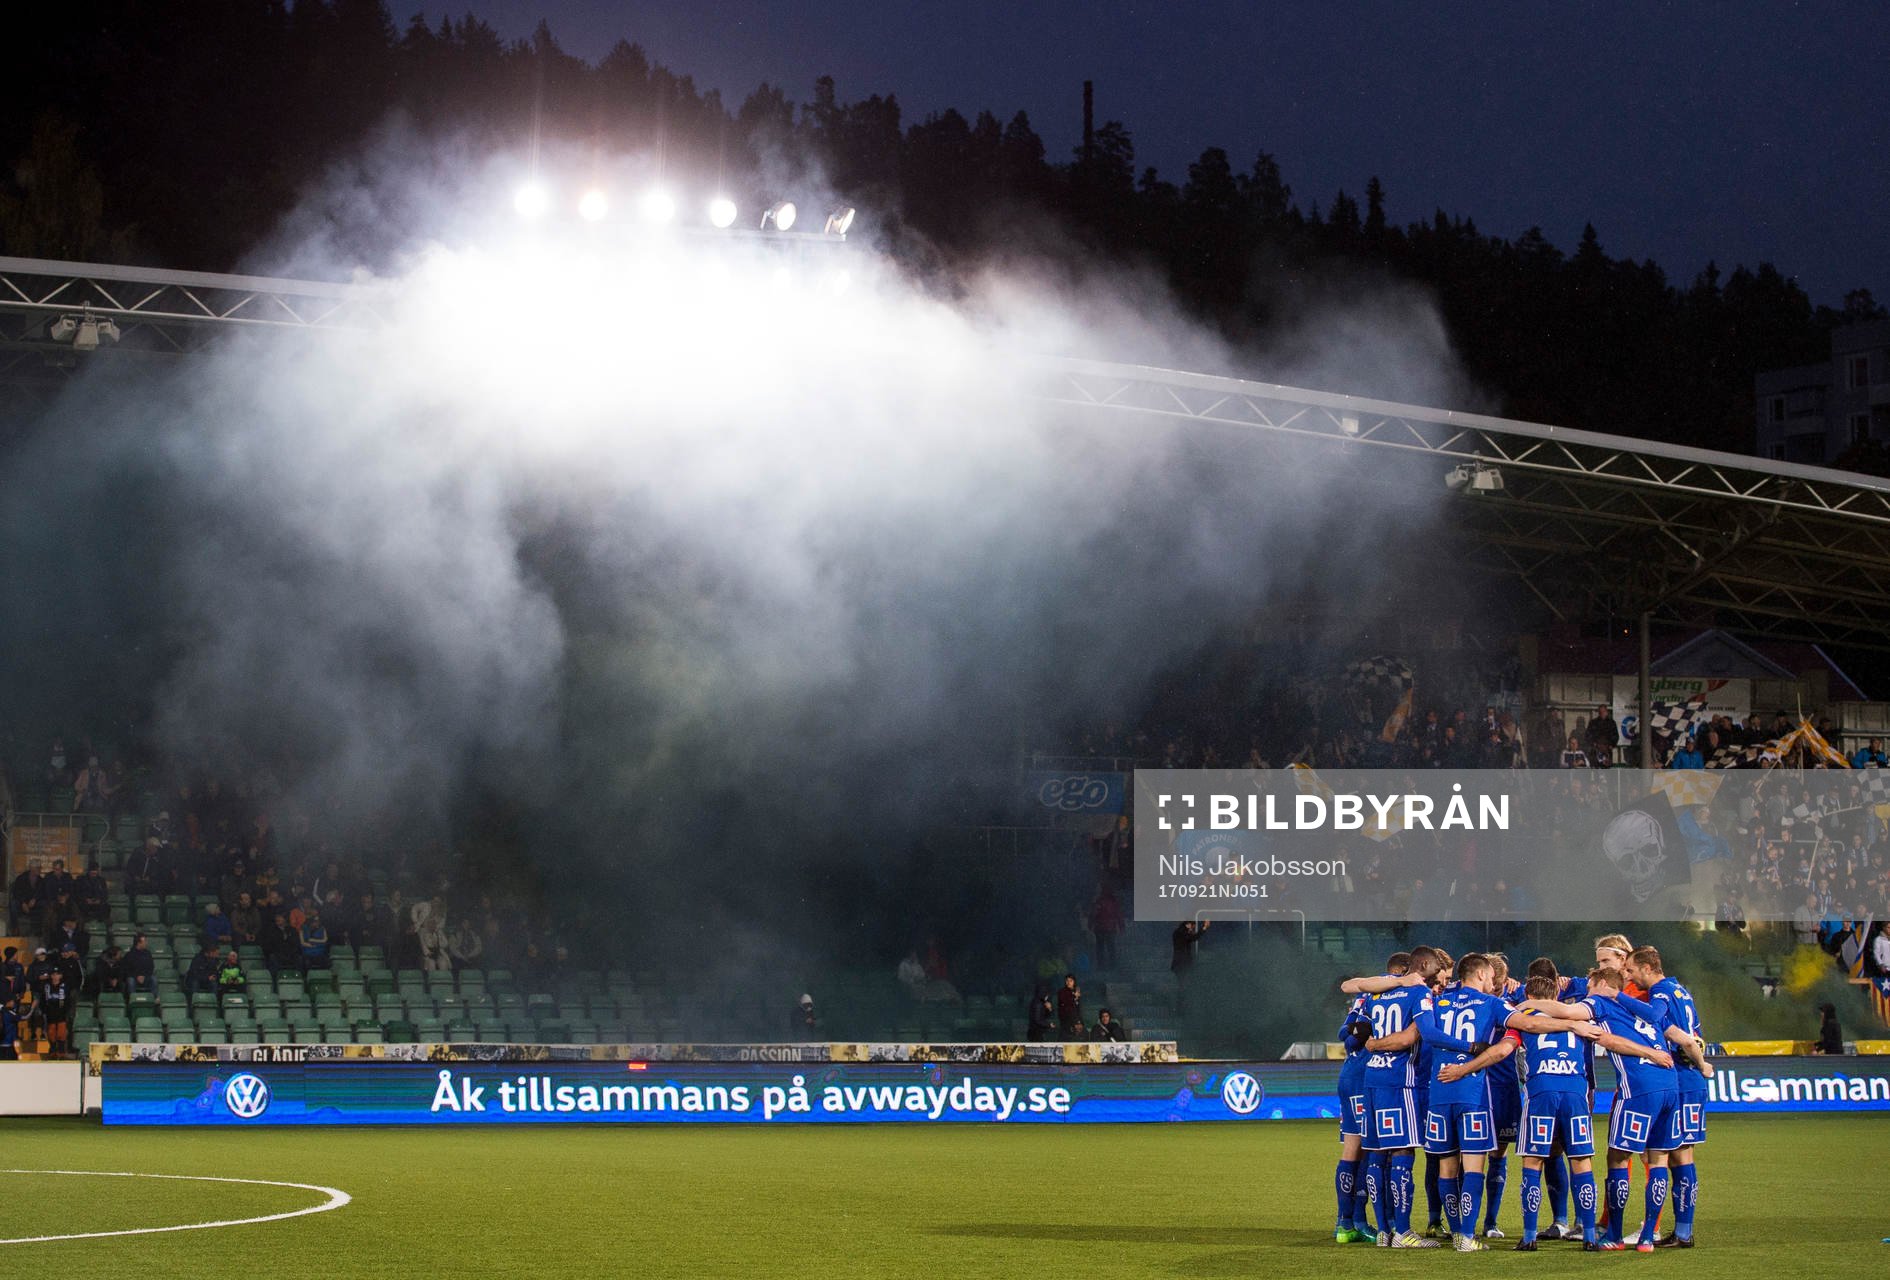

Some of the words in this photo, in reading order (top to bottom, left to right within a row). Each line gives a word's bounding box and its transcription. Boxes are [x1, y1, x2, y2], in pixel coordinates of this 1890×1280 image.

[1645, 677, 1703, 693] yberg
[1040, 776, 1108, 811] ego
[1371, 1003, 1402, 1039] 30
[1440, 1009, 1476, 1043] 16
[741, 1047, 802, 1062] PASSION
[1537, 1059, 1578, 1075] ABAX
[431, 1070, 486, 1112] Åk
[498, 1076, 750, 1112] tillsammans
[763, 1075, 809, 1120] på
[822, 1077, 1070, 1120] avwayday.se
[1707, 1070, 1890, 1102] illsamman
[1527, 1185, 1542, 1212] ego
[1579, 1183, 1594, 1210] ego
